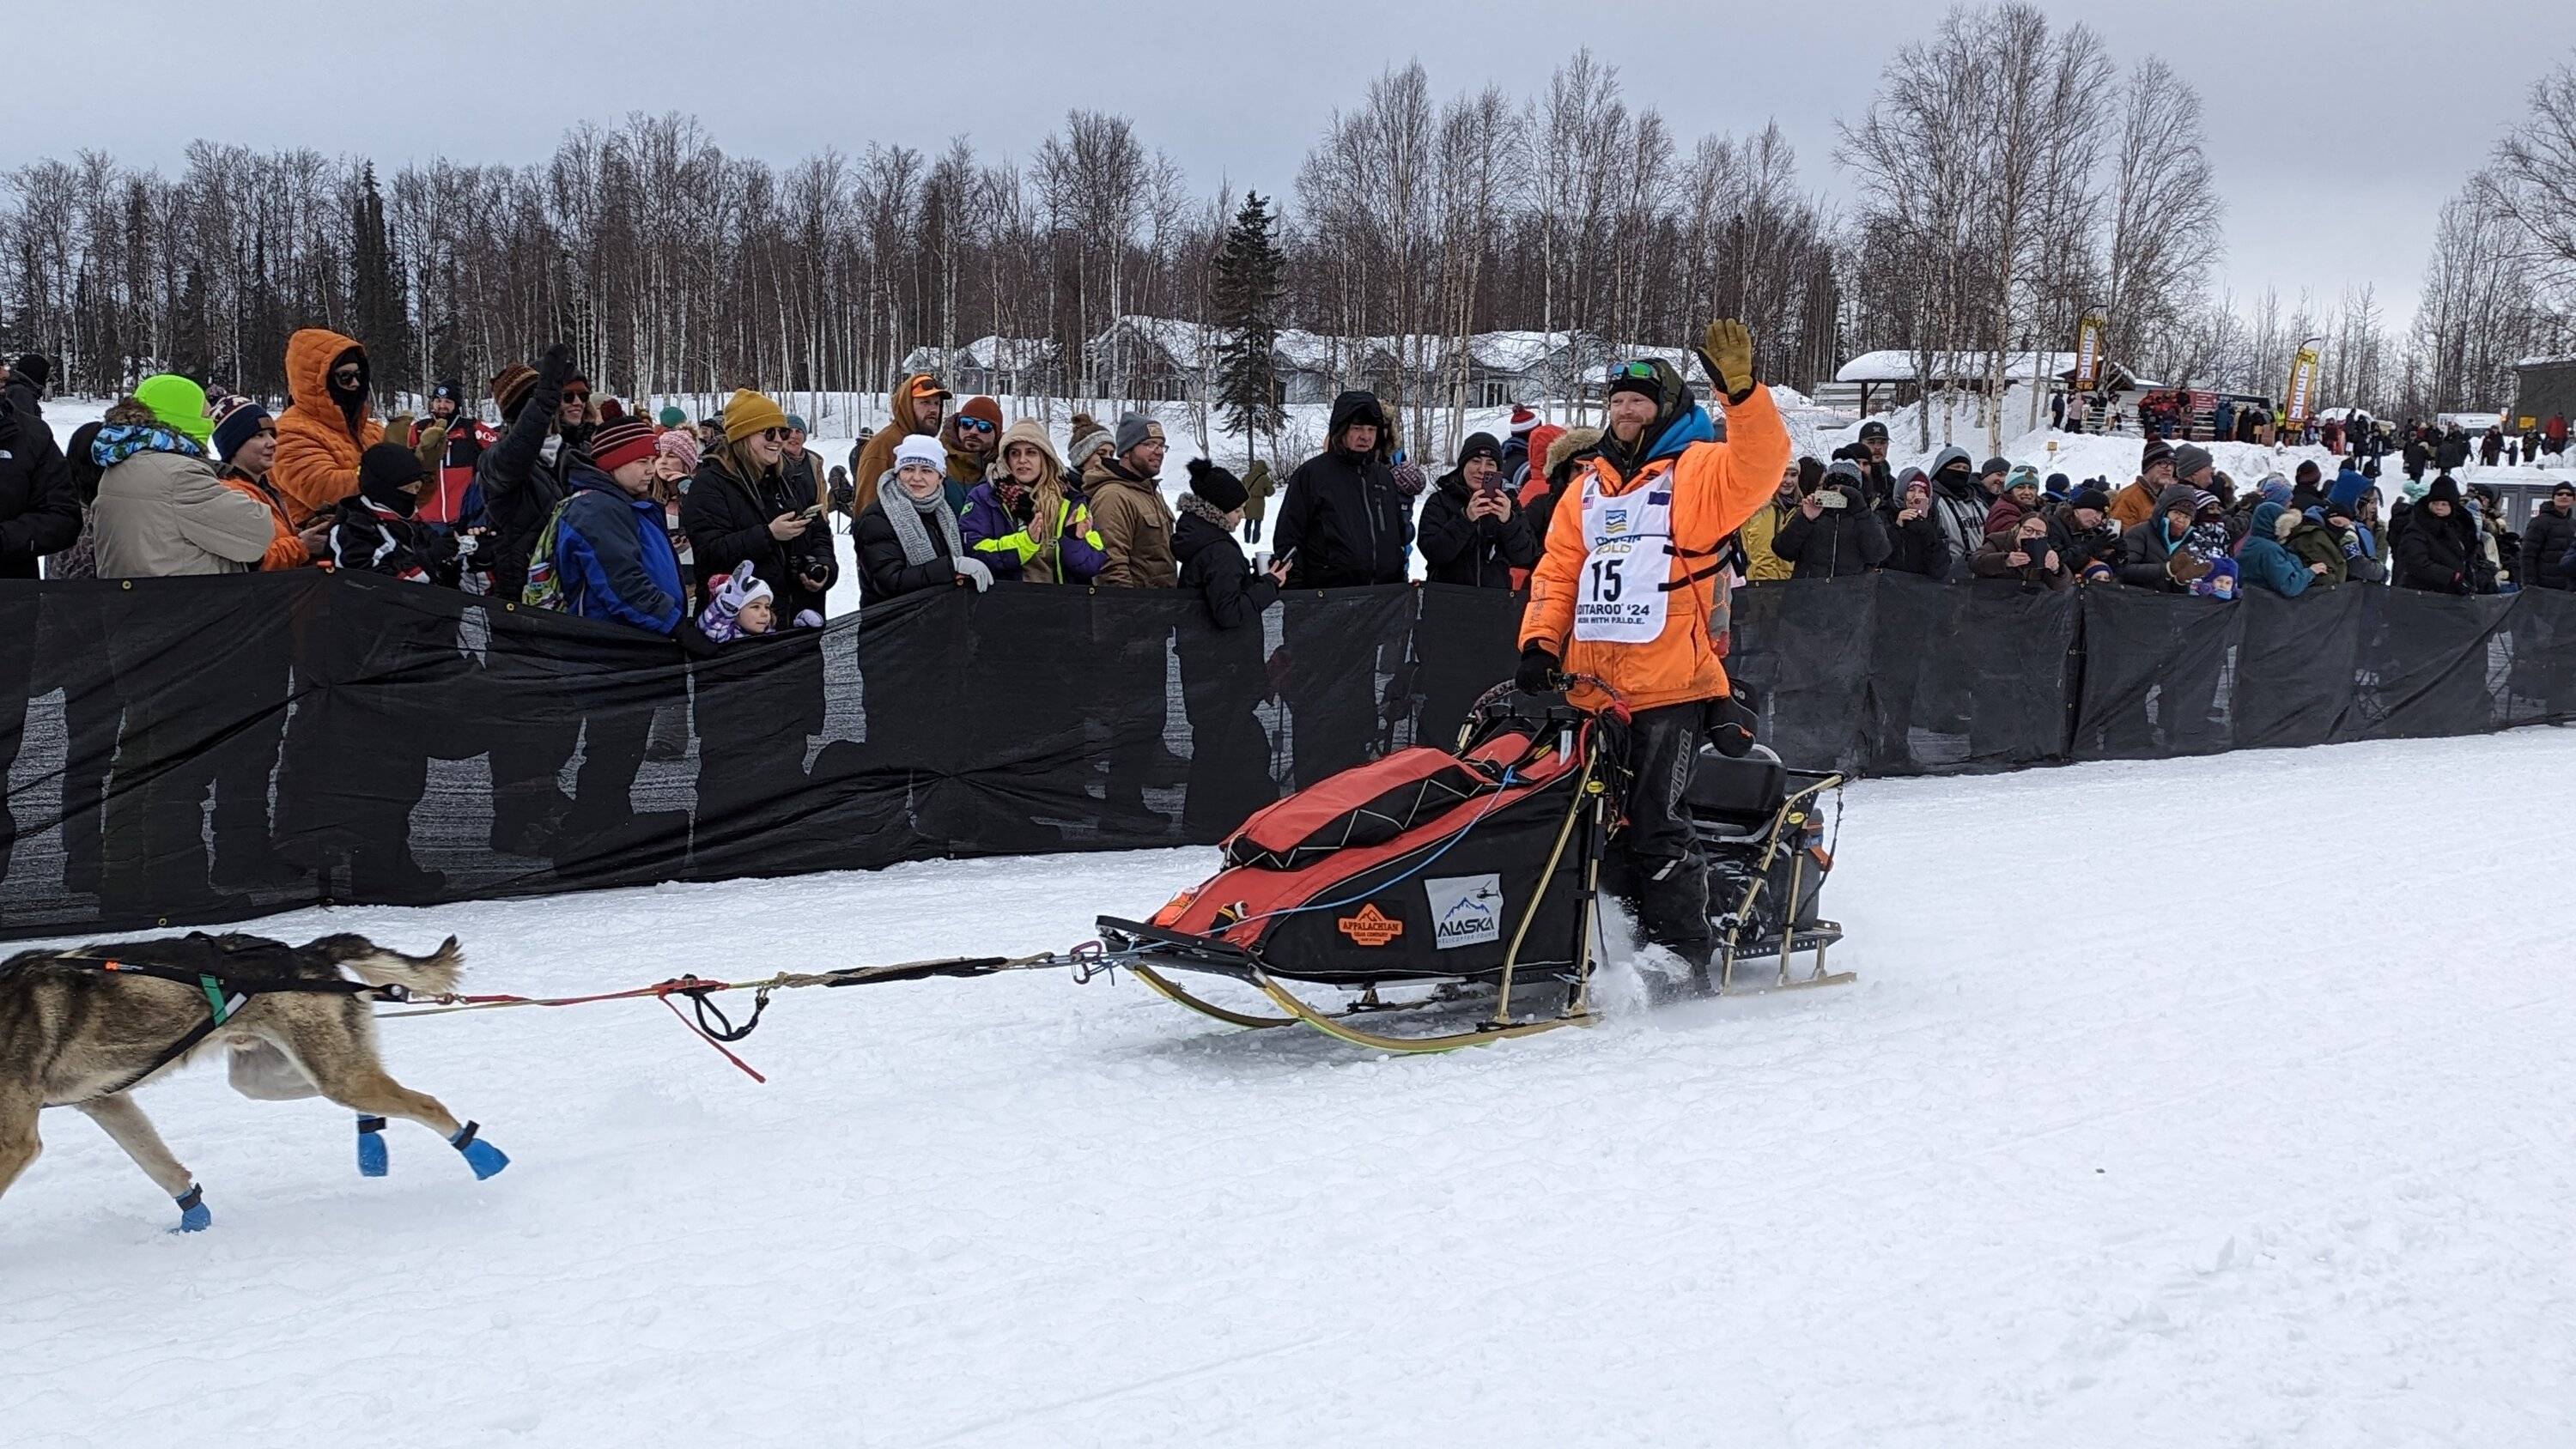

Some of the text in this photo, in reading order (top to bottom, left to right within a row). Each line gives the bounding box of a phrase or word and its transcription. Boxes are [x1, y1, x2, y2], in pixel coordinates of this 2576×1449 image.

[1592, 559, 1624, 602] 15
[1342, 921, 1399, 931] APPALACHIAN
[1437, 917, 1495, 937] ALASKA
